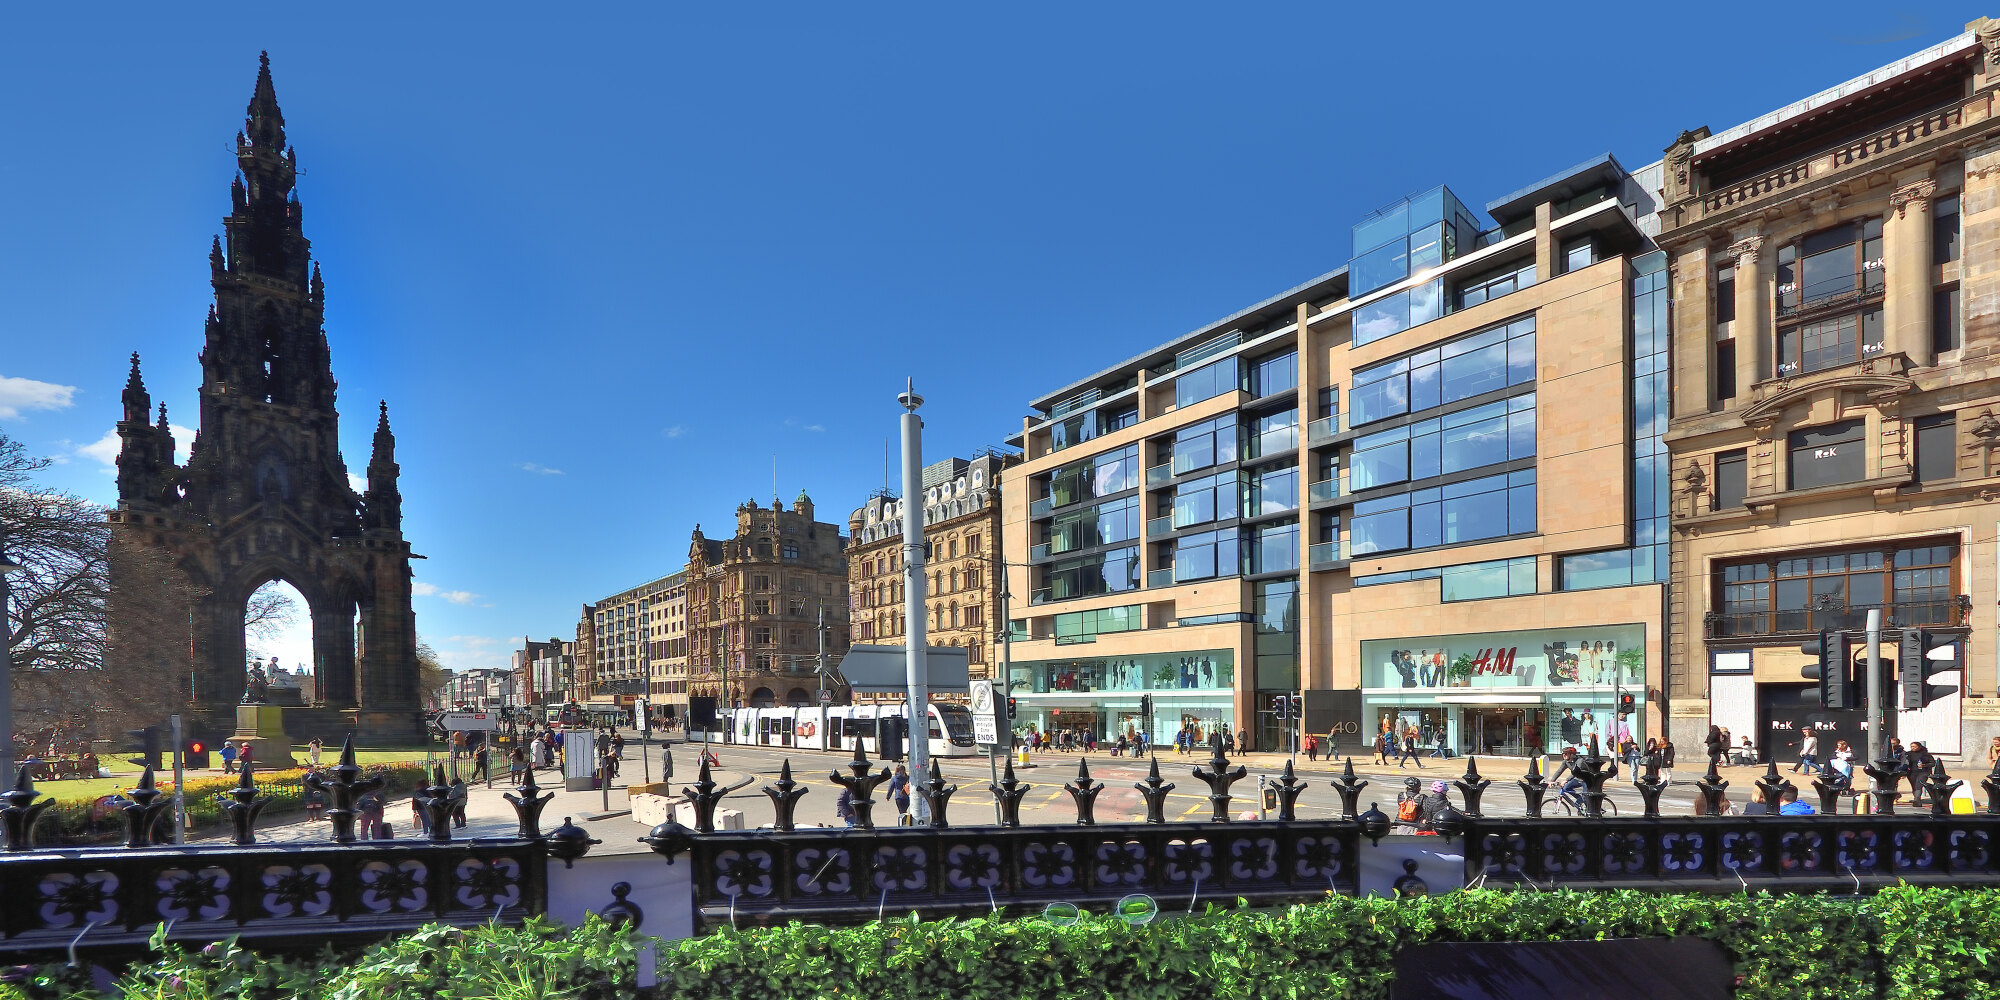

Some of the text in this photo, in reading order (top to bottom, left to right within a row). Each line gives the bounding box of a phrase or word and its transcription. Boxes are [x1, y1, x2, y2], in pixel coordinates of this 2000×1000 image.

[1469, 646, 1517, 675] H&M
[1332, 721, 1358, 734] 40
[977, 733, 995, 742] ENDS
